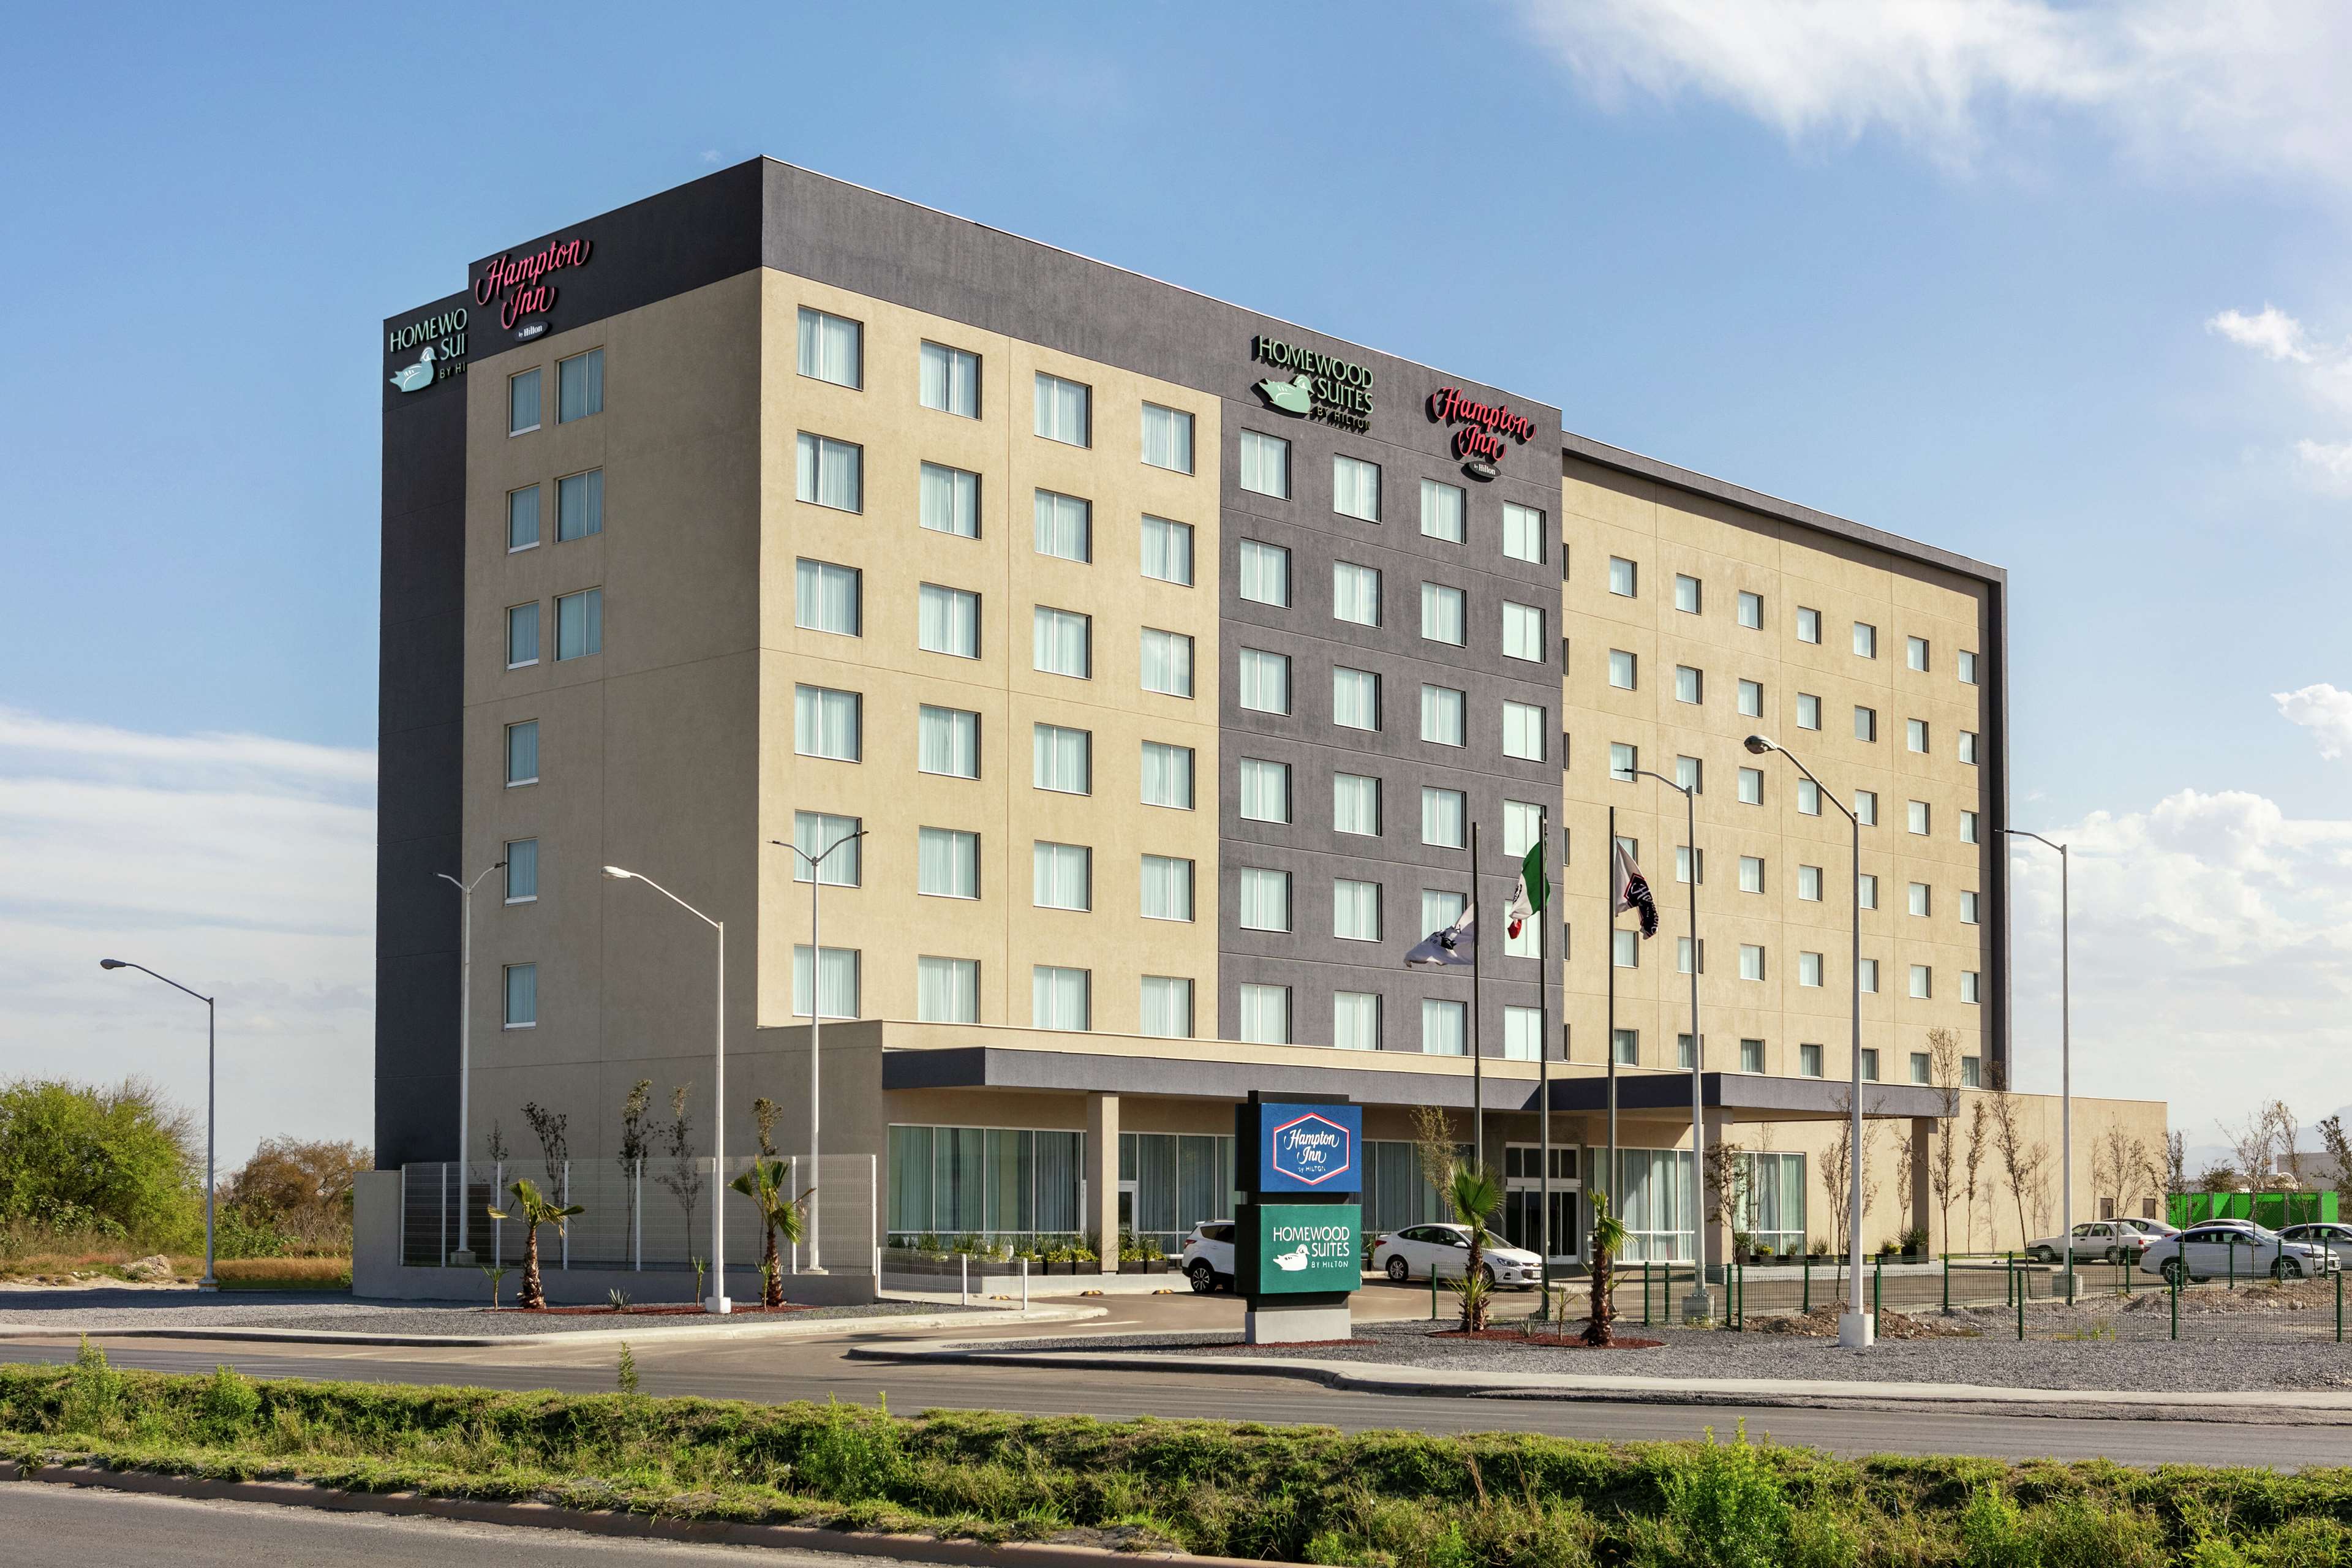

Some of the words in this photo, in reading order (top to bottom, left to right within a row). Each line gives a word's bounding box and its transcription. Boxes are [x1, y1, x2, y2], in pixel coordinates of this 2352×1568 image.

[475, 238, 590, 305] Hampton
[500, 284, 555, 330] Inn
[390, 308, 467, 352] HOMEWO
[524, 325, 543, 337] Hilton
[440, 333, 465, 361] SUI
[440, 366, 451, 379] BY
[1259, 334, 1374, 389] HOMEWOOD
[1317, 377, 1374, 414] SUITES
[1317, 405, 1329, 418] BY
[1334, 410, 1371, 430] HILTON
[1432, 386, 1537, 441] Hampton
[1458, 424, 1507, 461] Inn
[1479, 464, 1496, 475] Hilton
[1283, 1128, 1340, 1150] Hampton
[1297, 1145, 1327, 1165] Inn
[1273, 1226, 1350, 1242] HOMEWOOD
[1311, 1242, 1350, 1257] SUITES
